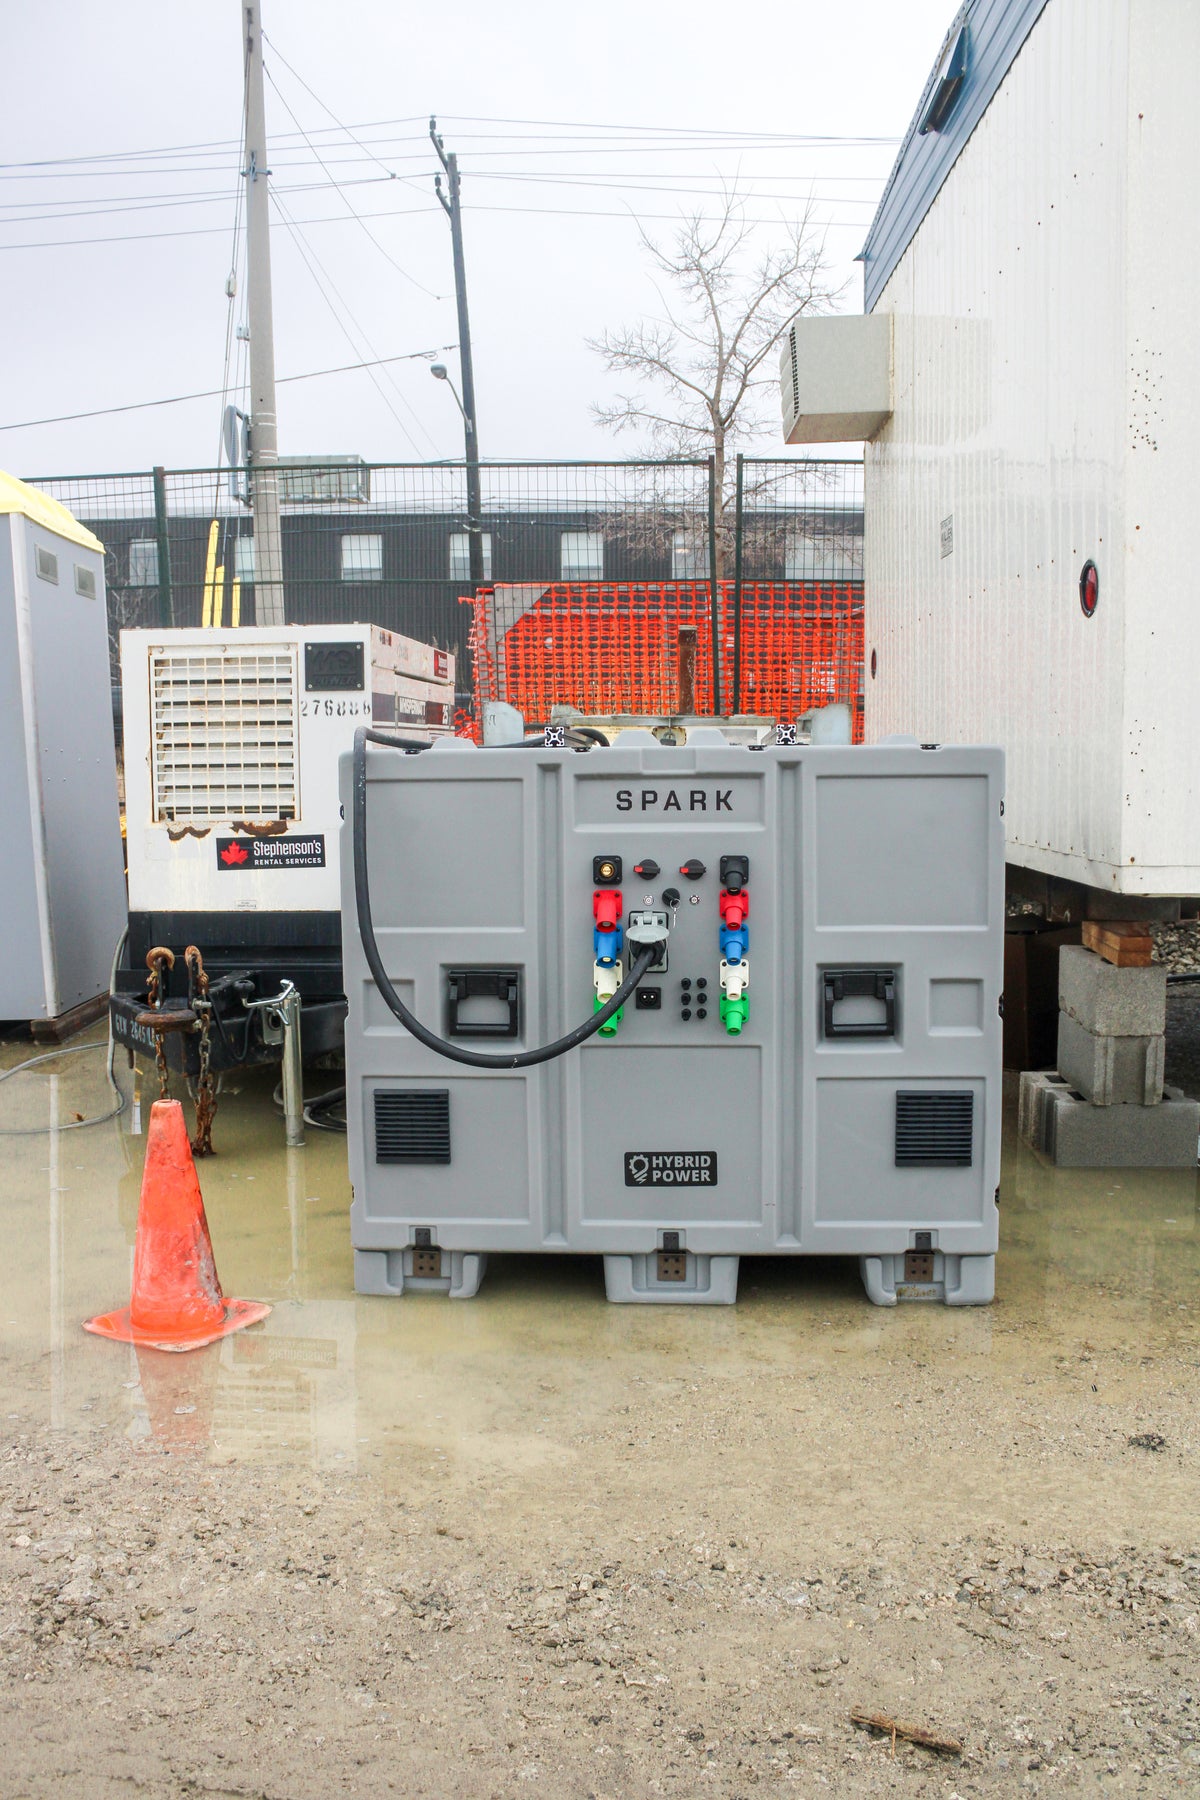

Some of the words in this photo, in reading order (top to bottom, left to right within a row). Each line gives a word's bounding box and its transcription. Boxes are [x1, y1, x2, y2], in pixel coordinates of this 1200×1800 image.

[616, 790, 733, 811] SPARK
[253, 840, 322, 857] Stephenson's
[254, 858, 283, 866] RENTAL
[285, 857, 322, 865] SERVICES
[652, 1155, 711, 1168] HYBRID
[652, 1169, 711, 1182] POWER
